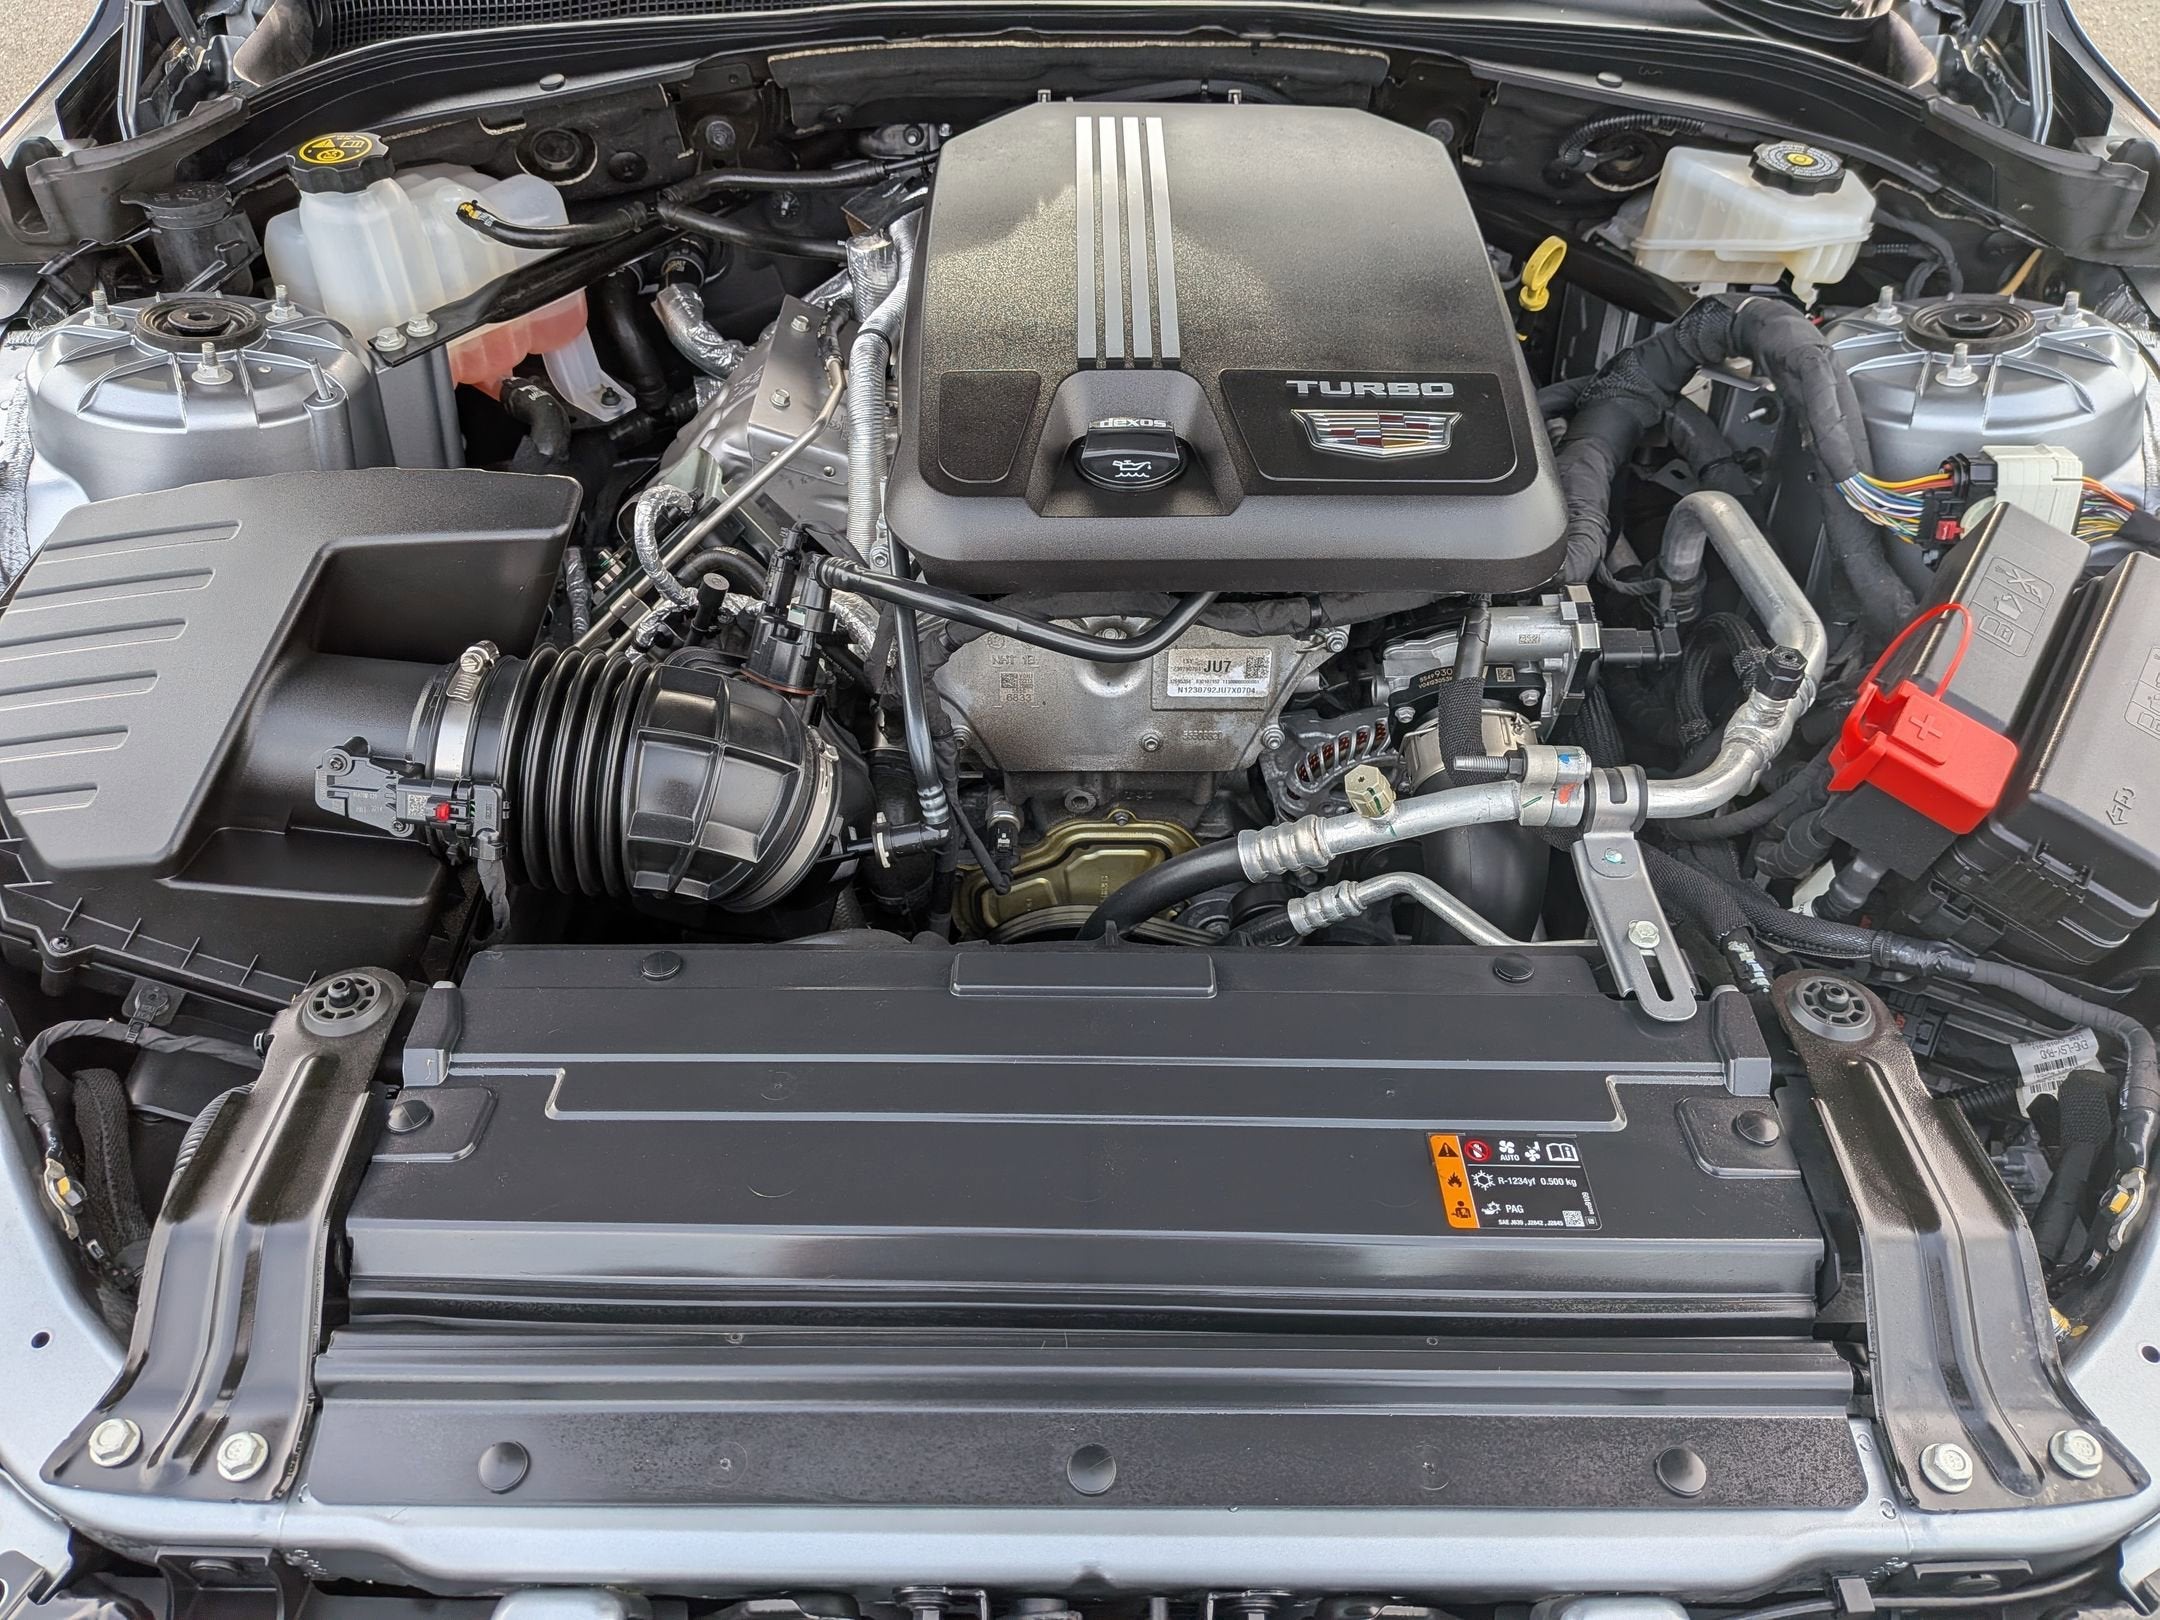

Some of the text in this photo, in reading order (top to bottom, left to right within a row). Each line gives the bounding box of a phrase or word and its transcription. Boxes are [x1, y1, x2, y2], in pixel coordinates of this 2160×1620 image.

[1286, 379, 1454, 398] TURBO
[1099, 417, 1167, 428] dexos
[1203, 660, 1232, 673] JU7
[1006, 693, 1032, 702] 6833
[1498, 1177, 1577, 1187] R-1234yf 0.500 kg
[1506, 1204, 1524, 1213] PAG
